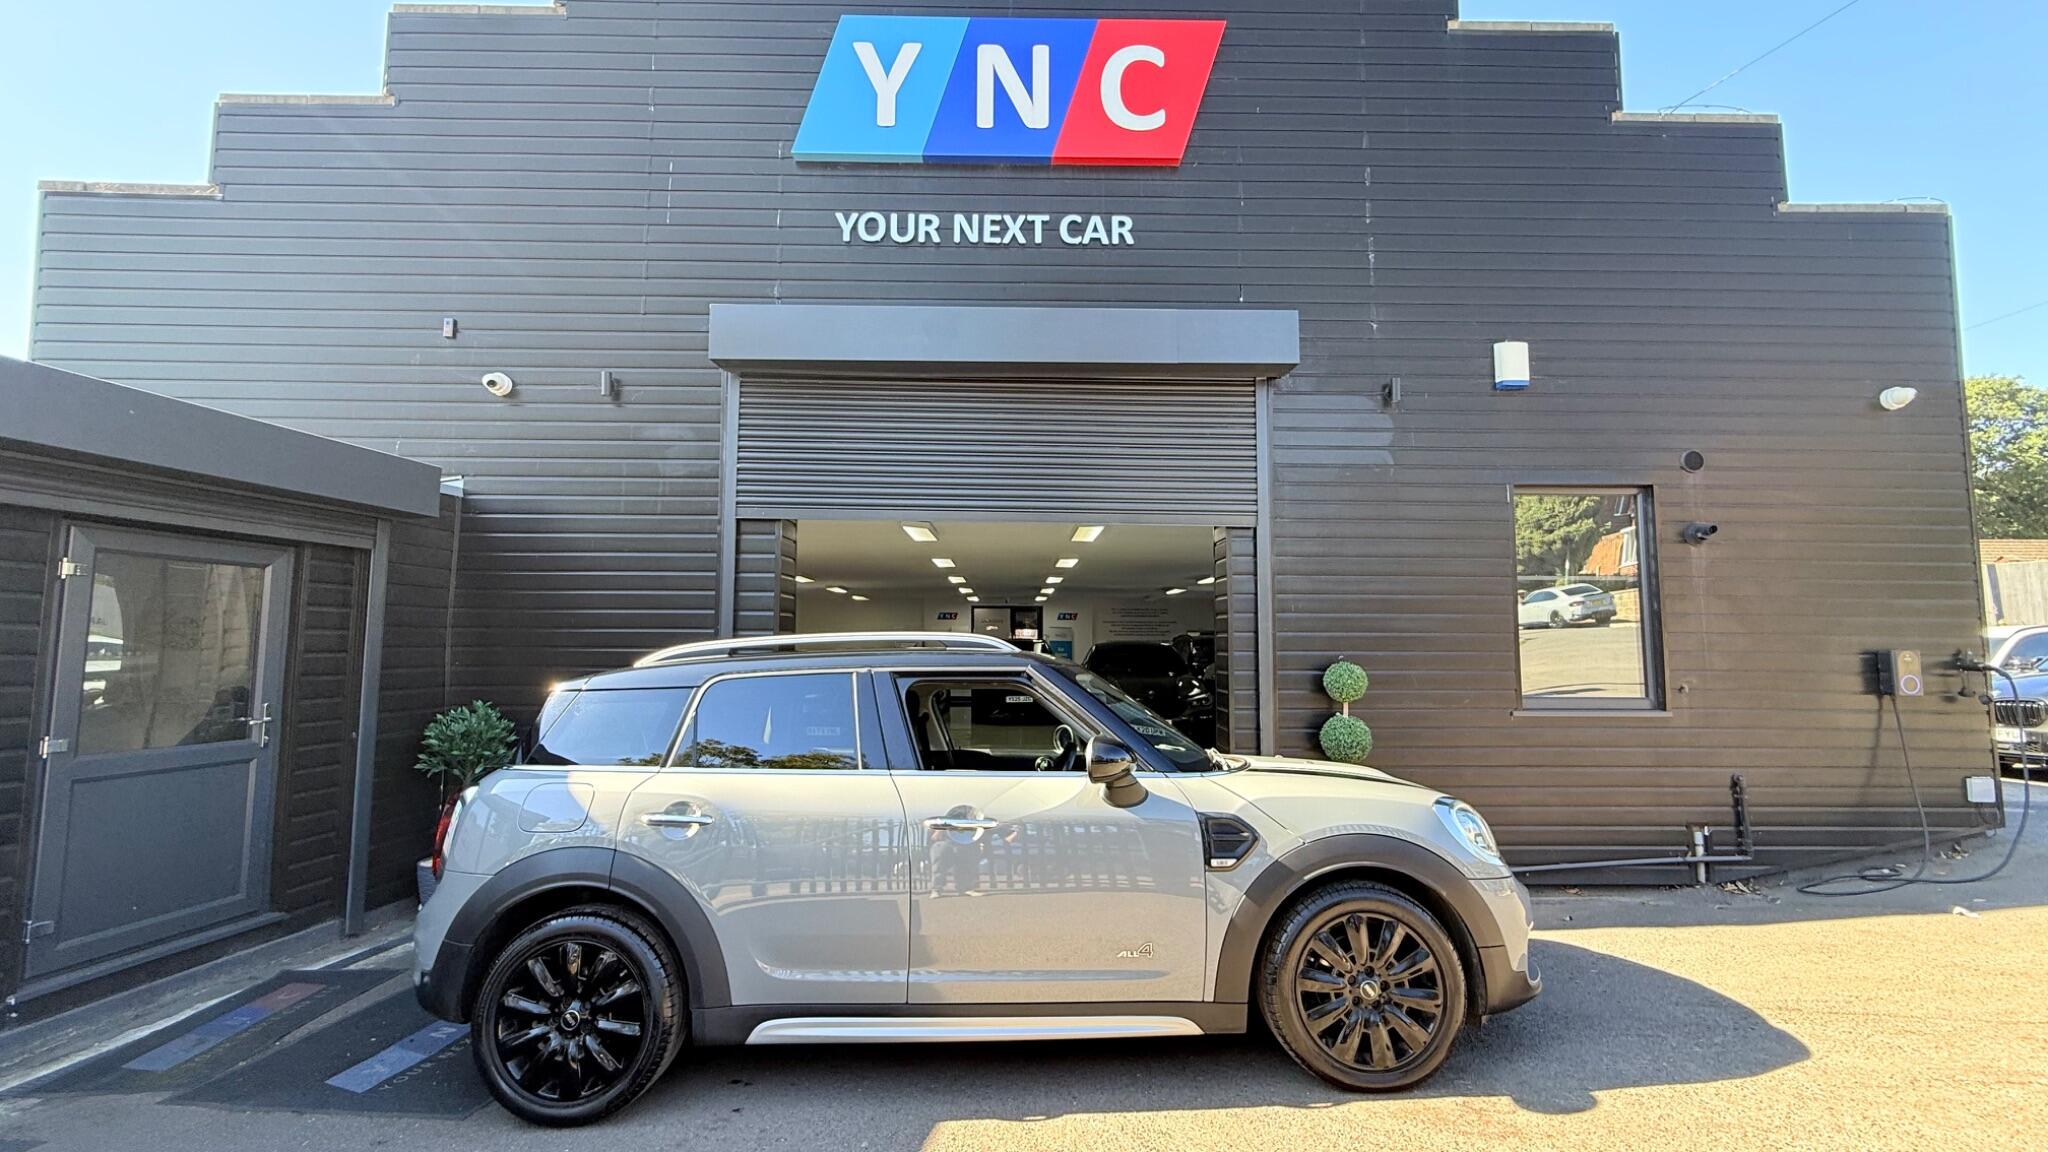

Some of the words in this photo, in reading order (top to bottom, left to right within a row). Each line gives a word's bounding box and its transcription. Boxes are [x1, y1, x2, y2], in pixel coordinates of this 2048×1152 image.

[852, 41, 1166, 131] YNC
[834, 211, 941, 244] YOUR
[953, 212, 1050, 245] NEXT
[1059, 213, 1135, 246] CAR
